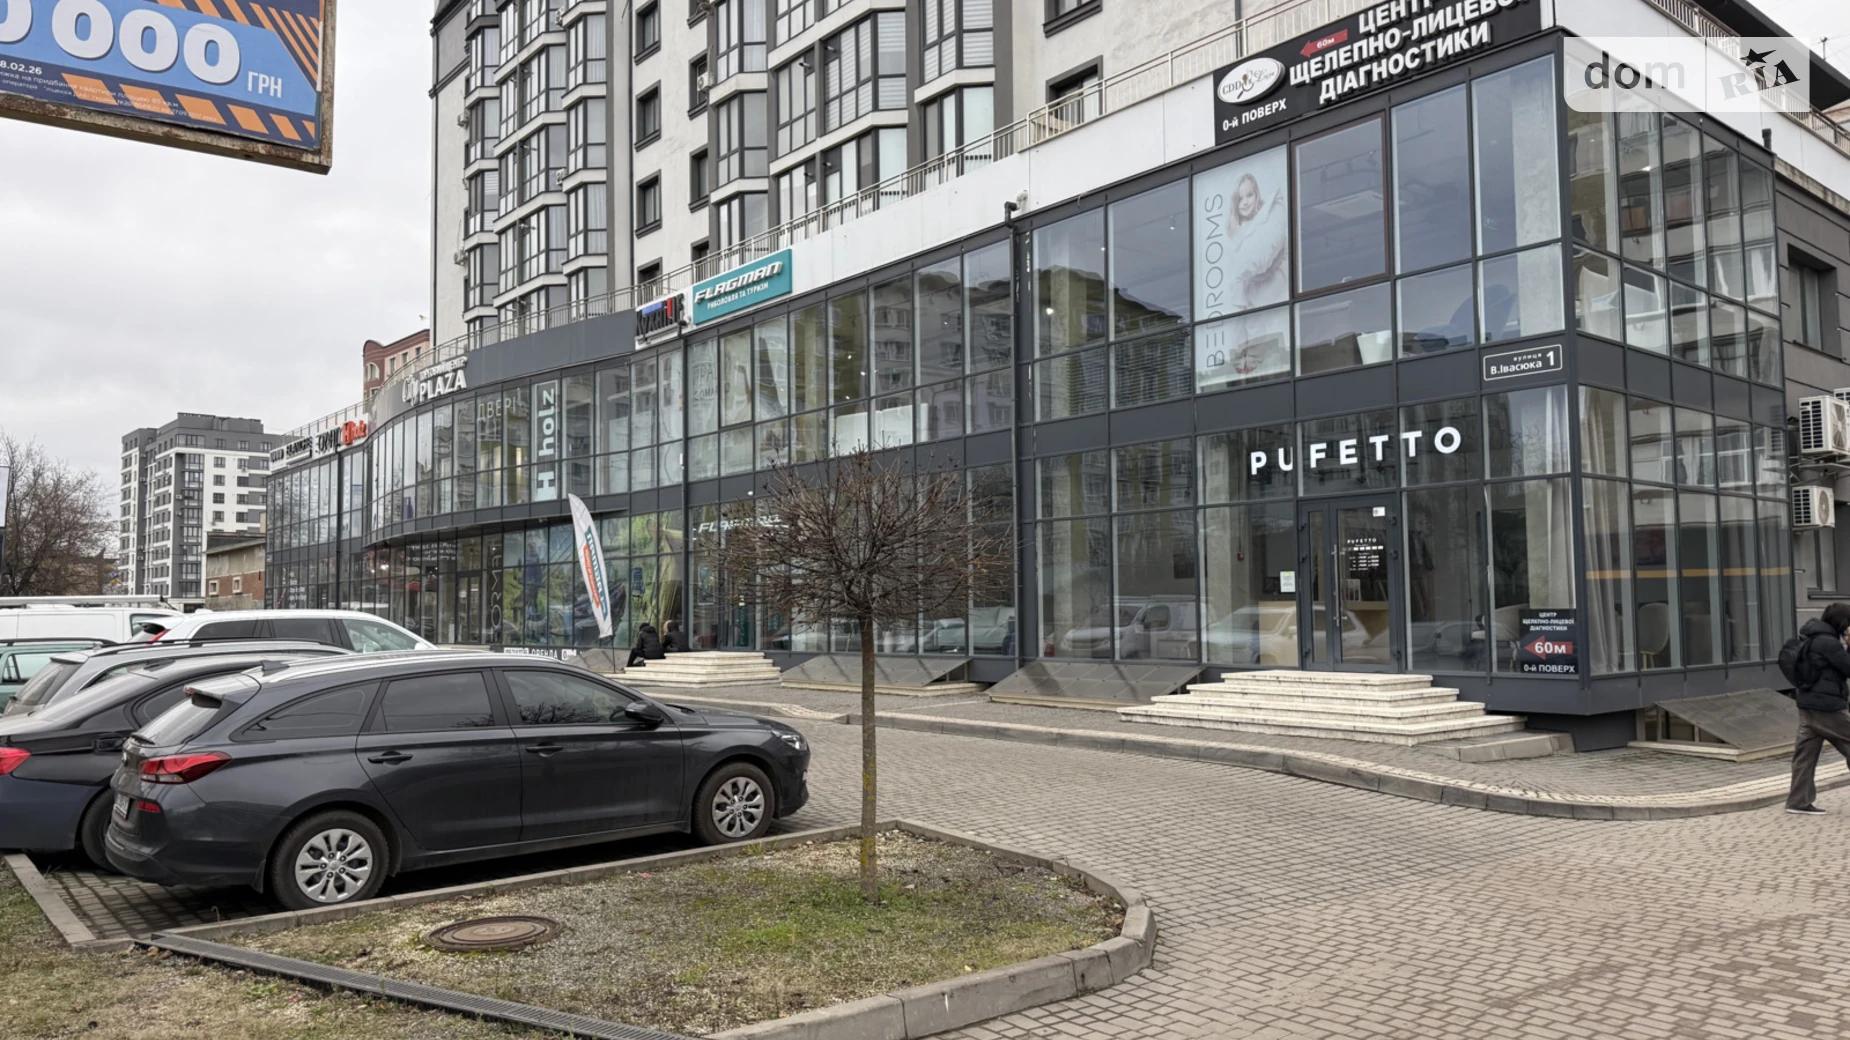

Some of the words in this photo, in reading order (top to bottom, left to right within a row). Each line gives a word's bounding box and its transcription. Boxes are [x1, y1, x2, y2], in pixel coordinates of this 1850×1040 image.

[1316, 38, 1335, 49] 60м
[1319, 20, 1491, 105] ДІАГНОСТИКИ
[247, 71, 283, 98] ГРН
[1241, 98, 1287, 125] ПОВЕРХ
[694, 261, 784, 304] FLAGMAN
[1490, 361, 1542, 375] В.Івасюка
[1546, 350, 1554, 367] 1
[419, 369, 467, 403] PLAZA
[1251, 426, 1461, 475] PUFETTO
[1534, 641, 1566, 654] 60м
[1538, 664, 1576, 673] ПОВЕРХ
